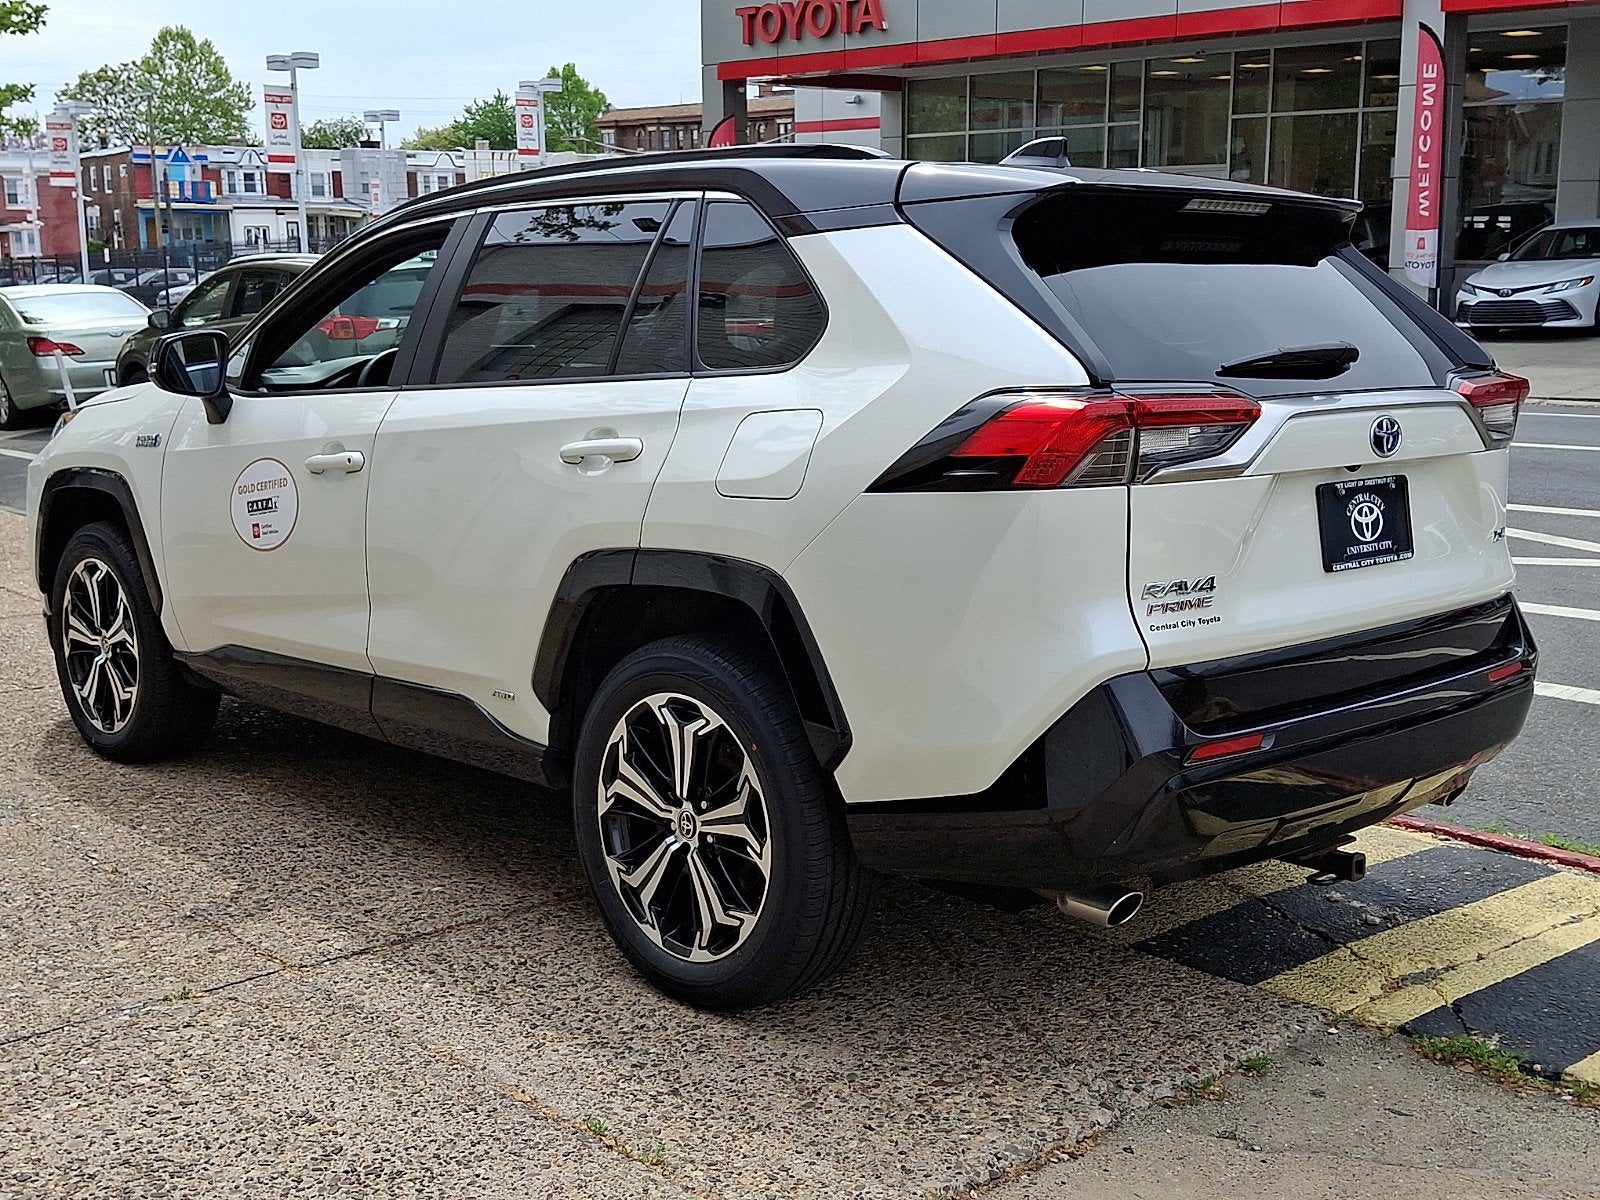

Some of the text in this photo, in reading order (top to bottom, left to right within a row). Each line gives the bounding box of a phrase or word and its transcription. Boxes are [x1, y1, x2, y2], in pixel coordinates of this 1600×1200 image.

[735, 0, 887, 45] TOYOTA
[238, 477, 288, 495] GOLD CERTIFIED
[1346, 493, 1386, 516] CENTRAL CITY
[1346, 540, 1393, 555] UNIVERSITY CITY
[1332, 562, 1360, 571] CENTRAL
[1361, 559, 1374, 567] CITY
[1141, 574, 1217, 600] RAV4
[1146, 595, 1215, 616] PRIME
[1149, 616, 1221, 632] Central City Toyota
